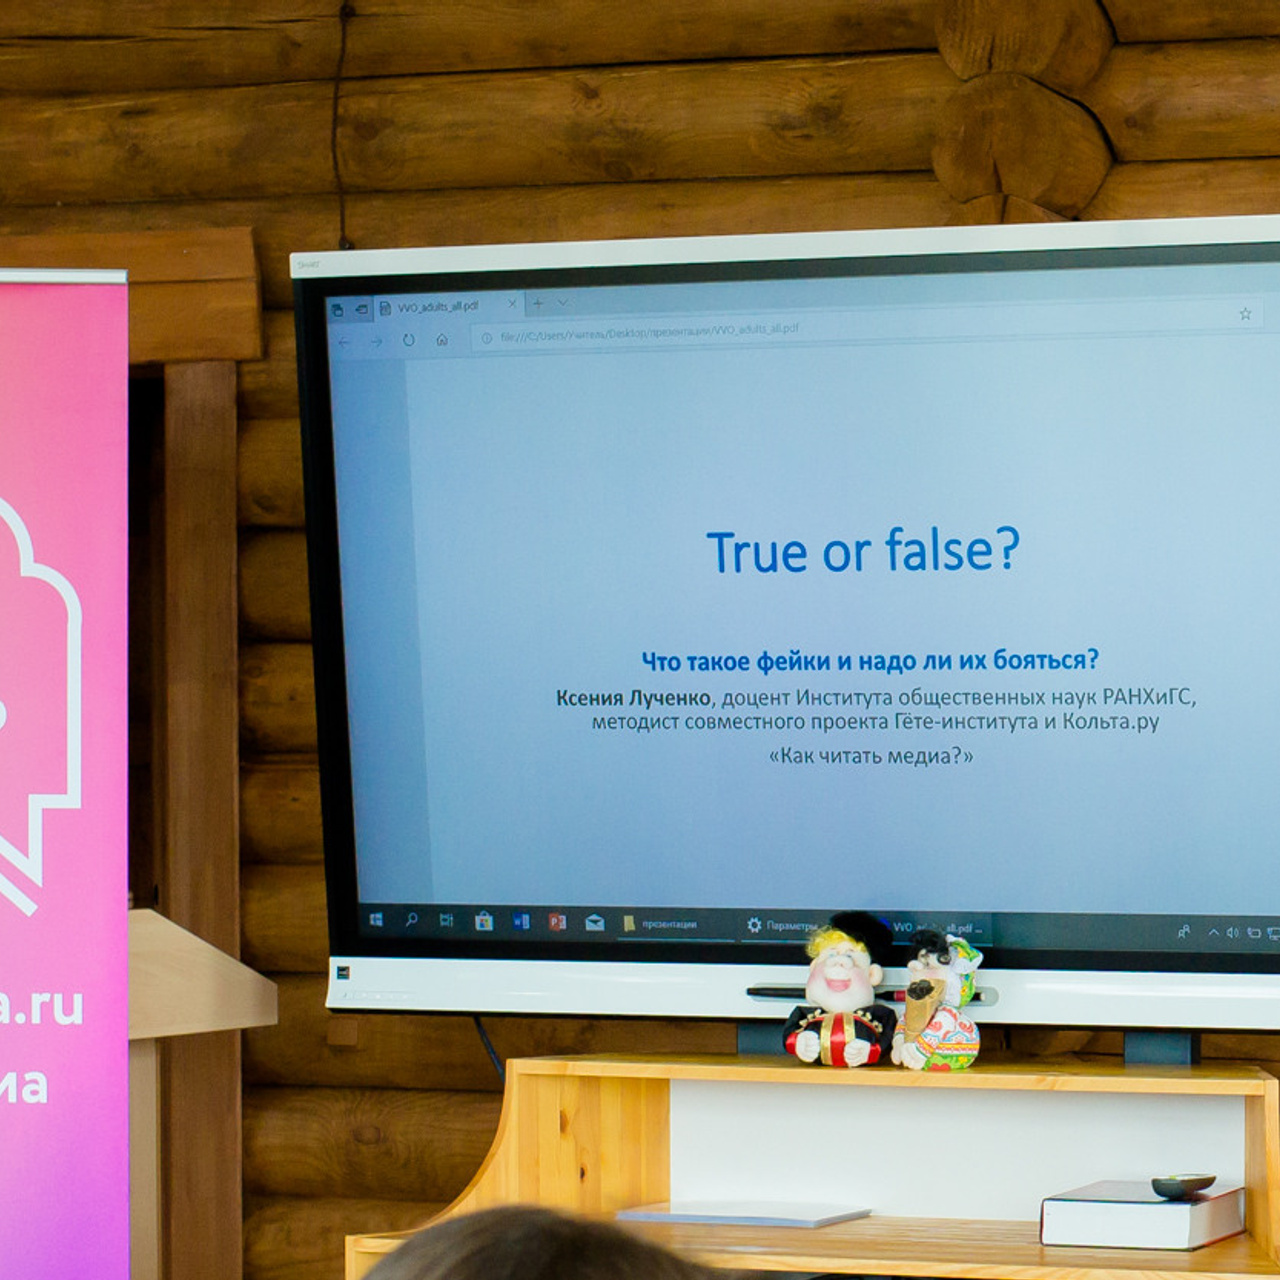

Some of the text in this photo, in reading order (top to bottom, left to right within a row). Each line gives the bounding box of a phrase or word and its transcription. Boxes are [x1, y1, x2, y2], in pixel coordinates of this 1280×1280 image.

[706, 525, 1020, 574] True or false?
[642, 647, 1100, 676] Что такое фейки и надо ли их бояться?
[556, 687, 1197, 711] Ксения Лученко, доцент Института общественных наук РАНХиГС,
[591, 712, 1160, 735] методист совместного проекта Гёте-института и Кольта.ру
[769, 746, 974, 768] «Как читать медиа?»
[642, 919, 698, 931] презентации
